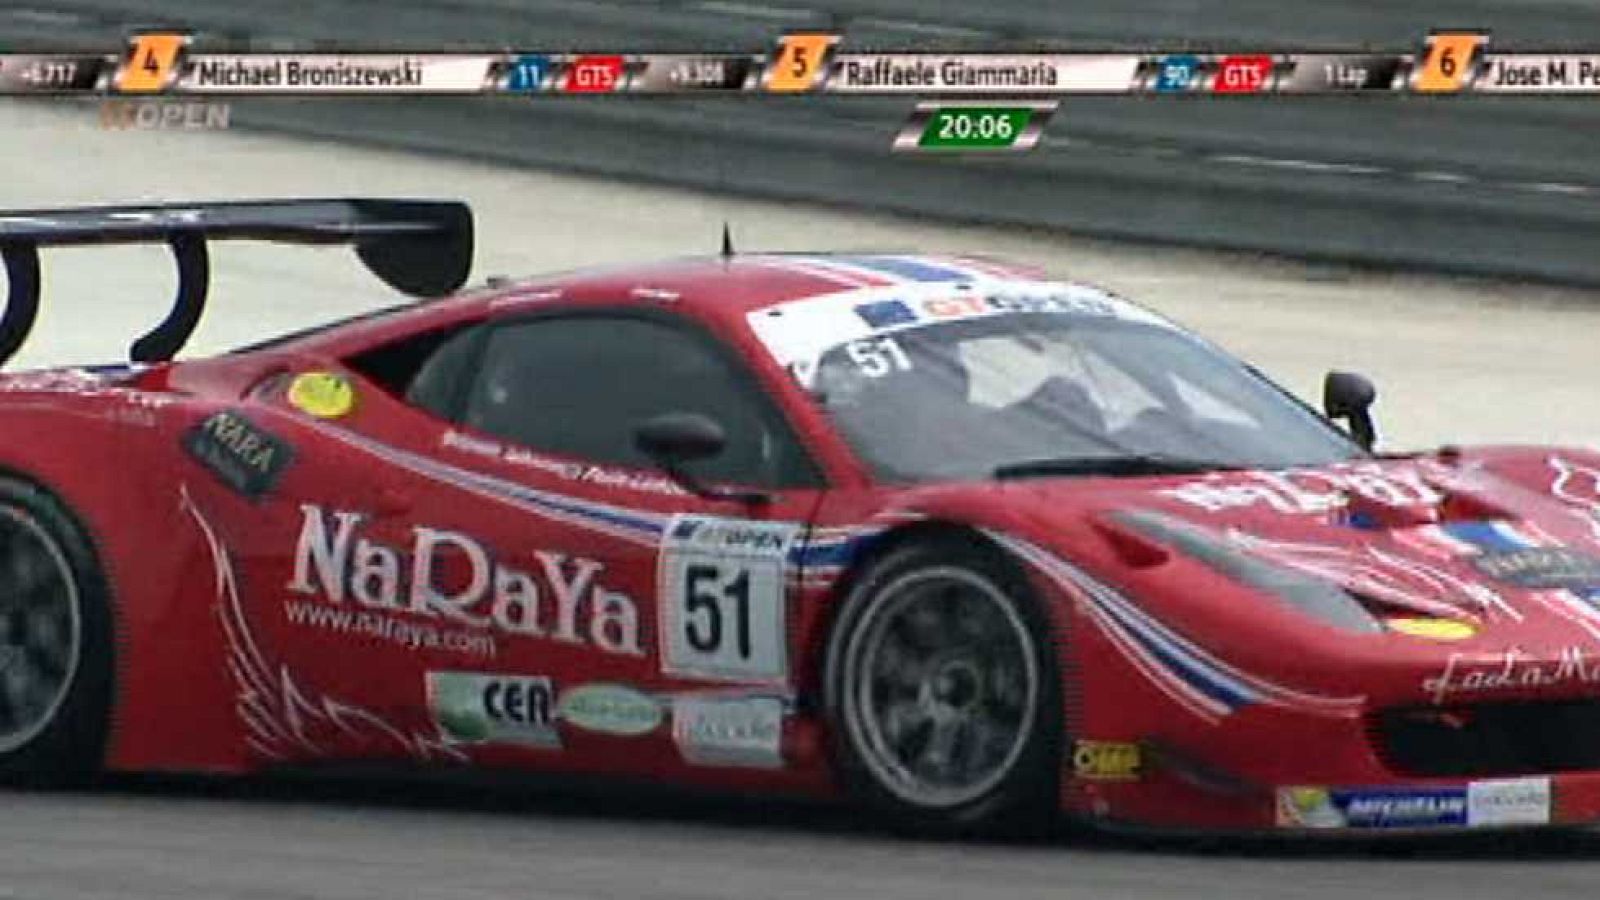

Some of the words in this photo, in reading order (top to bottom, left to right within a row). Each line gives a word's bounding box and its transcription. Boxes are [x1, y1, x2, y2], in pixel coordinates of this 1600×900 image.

[849, 336, 911, 378] 51
[286, 503, 645, 657] NaRaYa
[684, 564, 752, 660] 51
[284, 599, 497, 658] www.naraya.com
